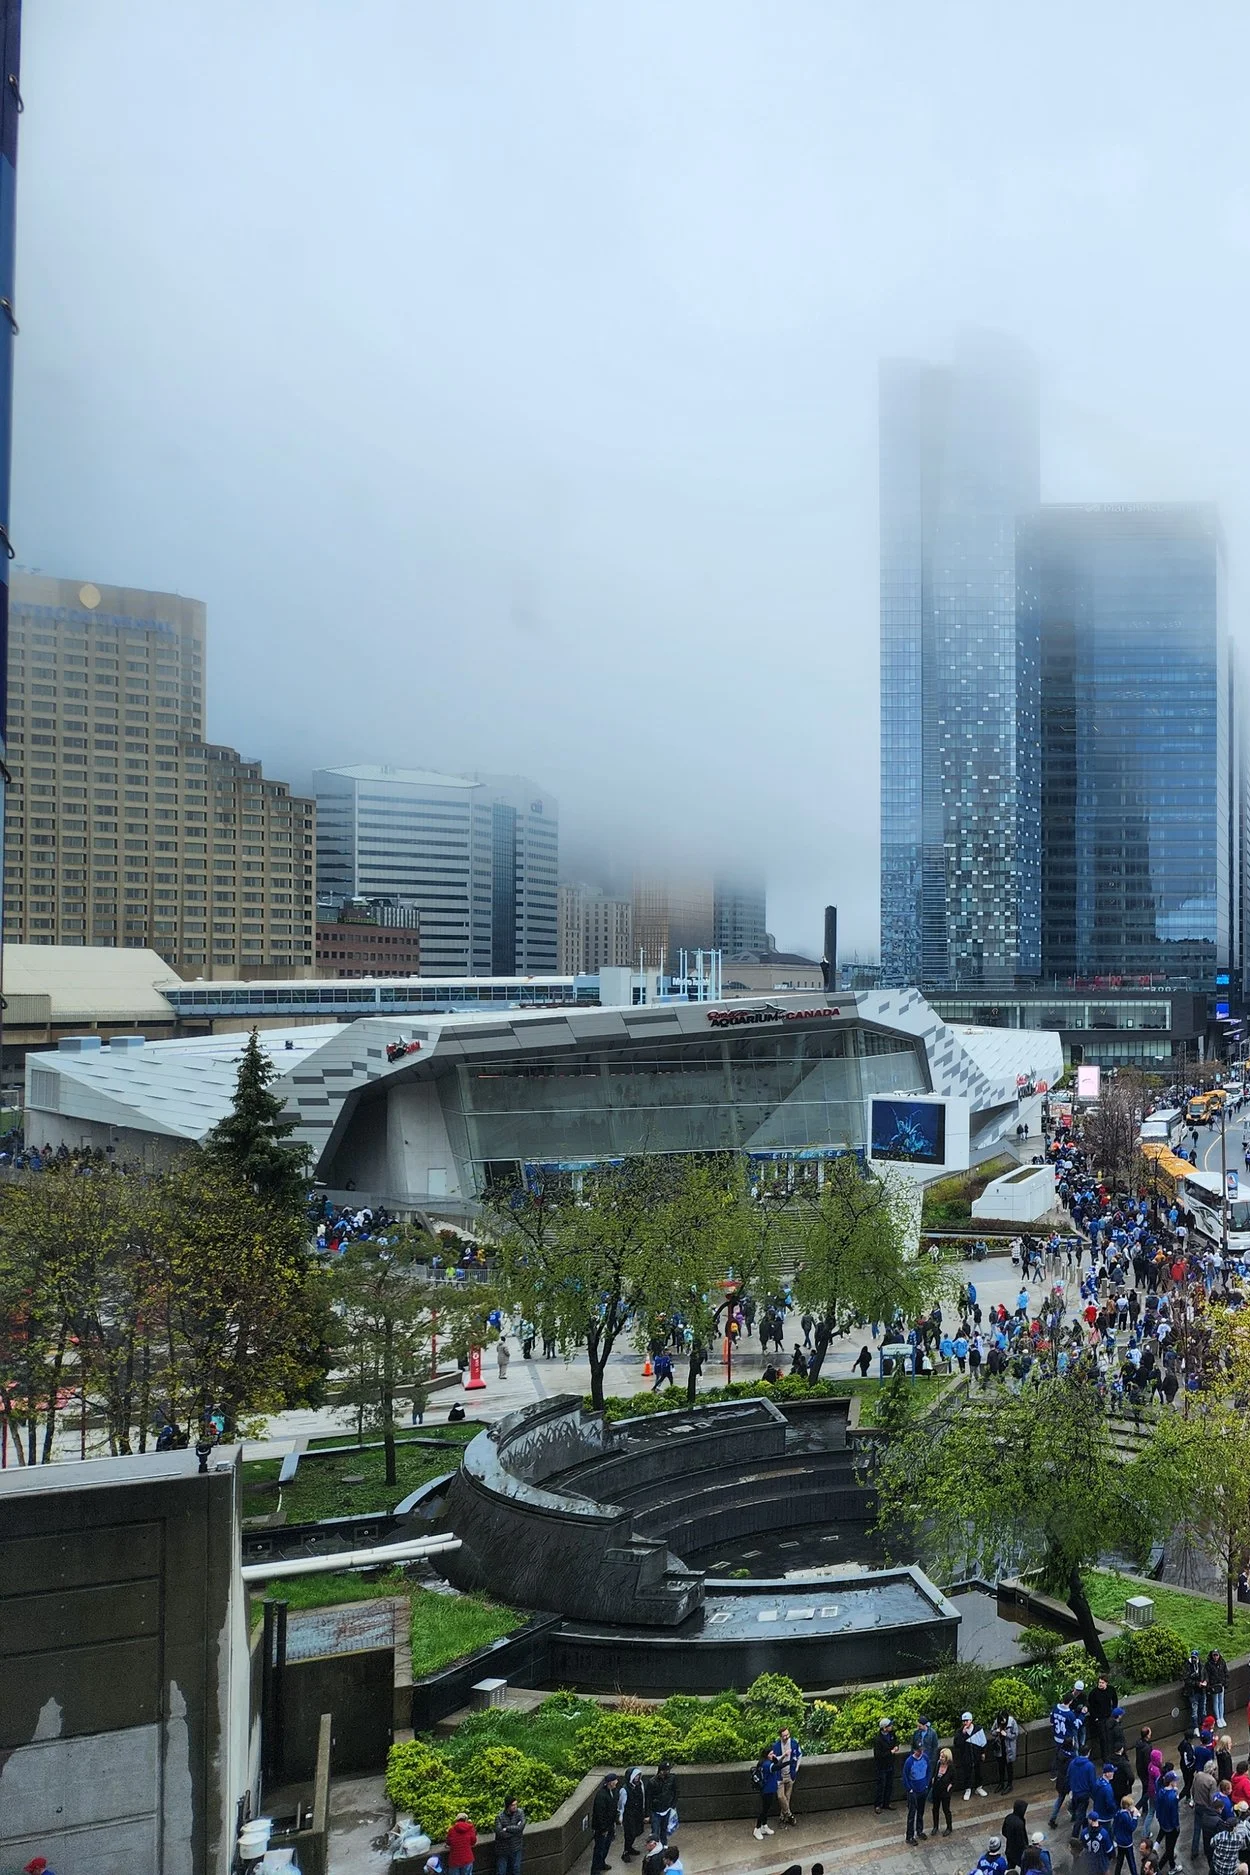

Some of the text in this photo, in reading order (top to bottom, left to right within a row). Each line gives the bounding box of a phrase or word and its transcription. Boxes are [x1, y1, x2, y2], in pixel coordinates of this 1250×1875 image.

[710, 1013, 778, 1028] AQUARIUM
[786, 1007, 841, 1021] CANADA
[1054, 1719, 1066, 1736] 34
[1086, 1840, 1100, 1853] 19
